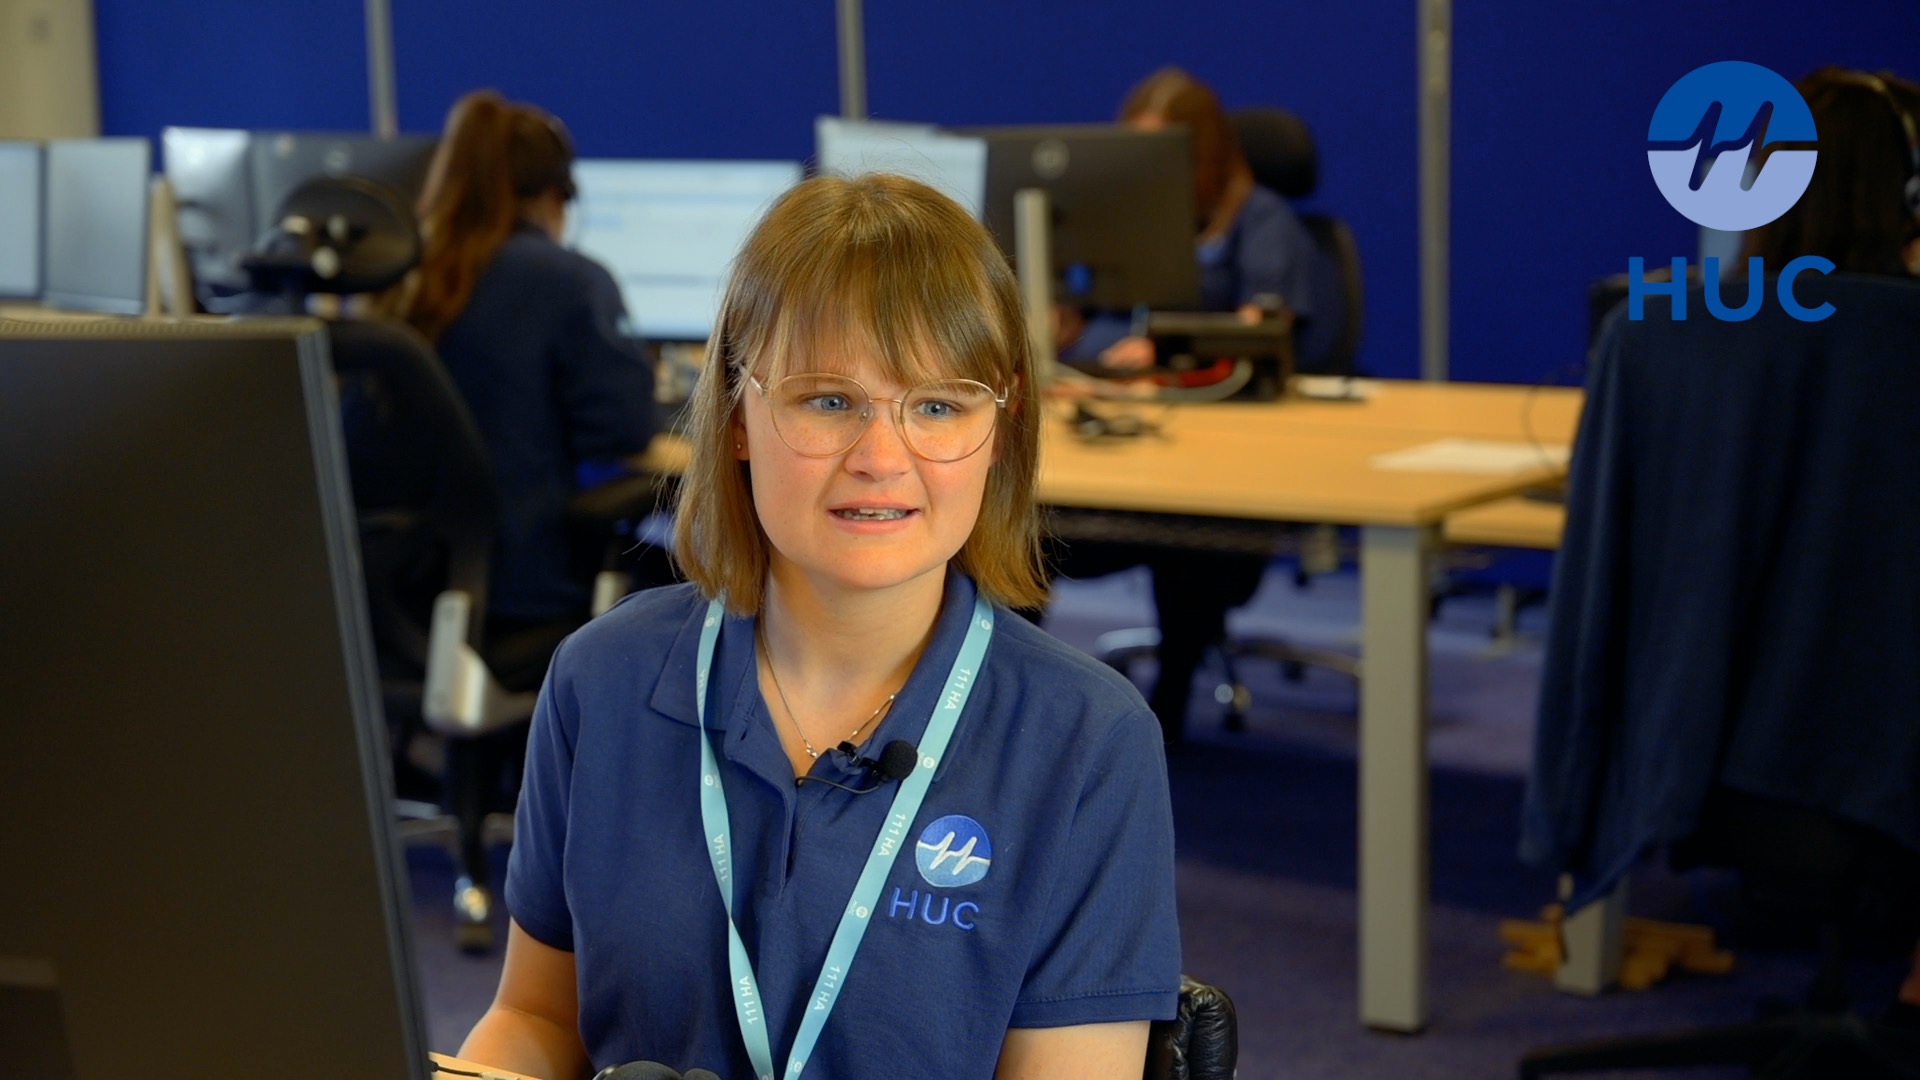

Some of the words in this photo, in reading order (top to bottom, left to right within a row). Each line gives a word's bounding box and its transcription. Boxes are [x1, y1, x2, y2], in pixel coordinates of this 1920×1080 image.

[954, 668, 971, 689] 111
[944, 690, 961, 709] HA
[889, 814, 906, 835] 111
[713, 833, 726, 855] HA
[877, 837, 896, 856] HA
[717, 858, 728, 882] 111
[889, 886, 979, 930] HUC
[739, 975, 753, 997] HA
[823, 966, 841, 989] 111
[814, 990, 831, 1010] HA
[743, 1000, 759, 1025] 111
